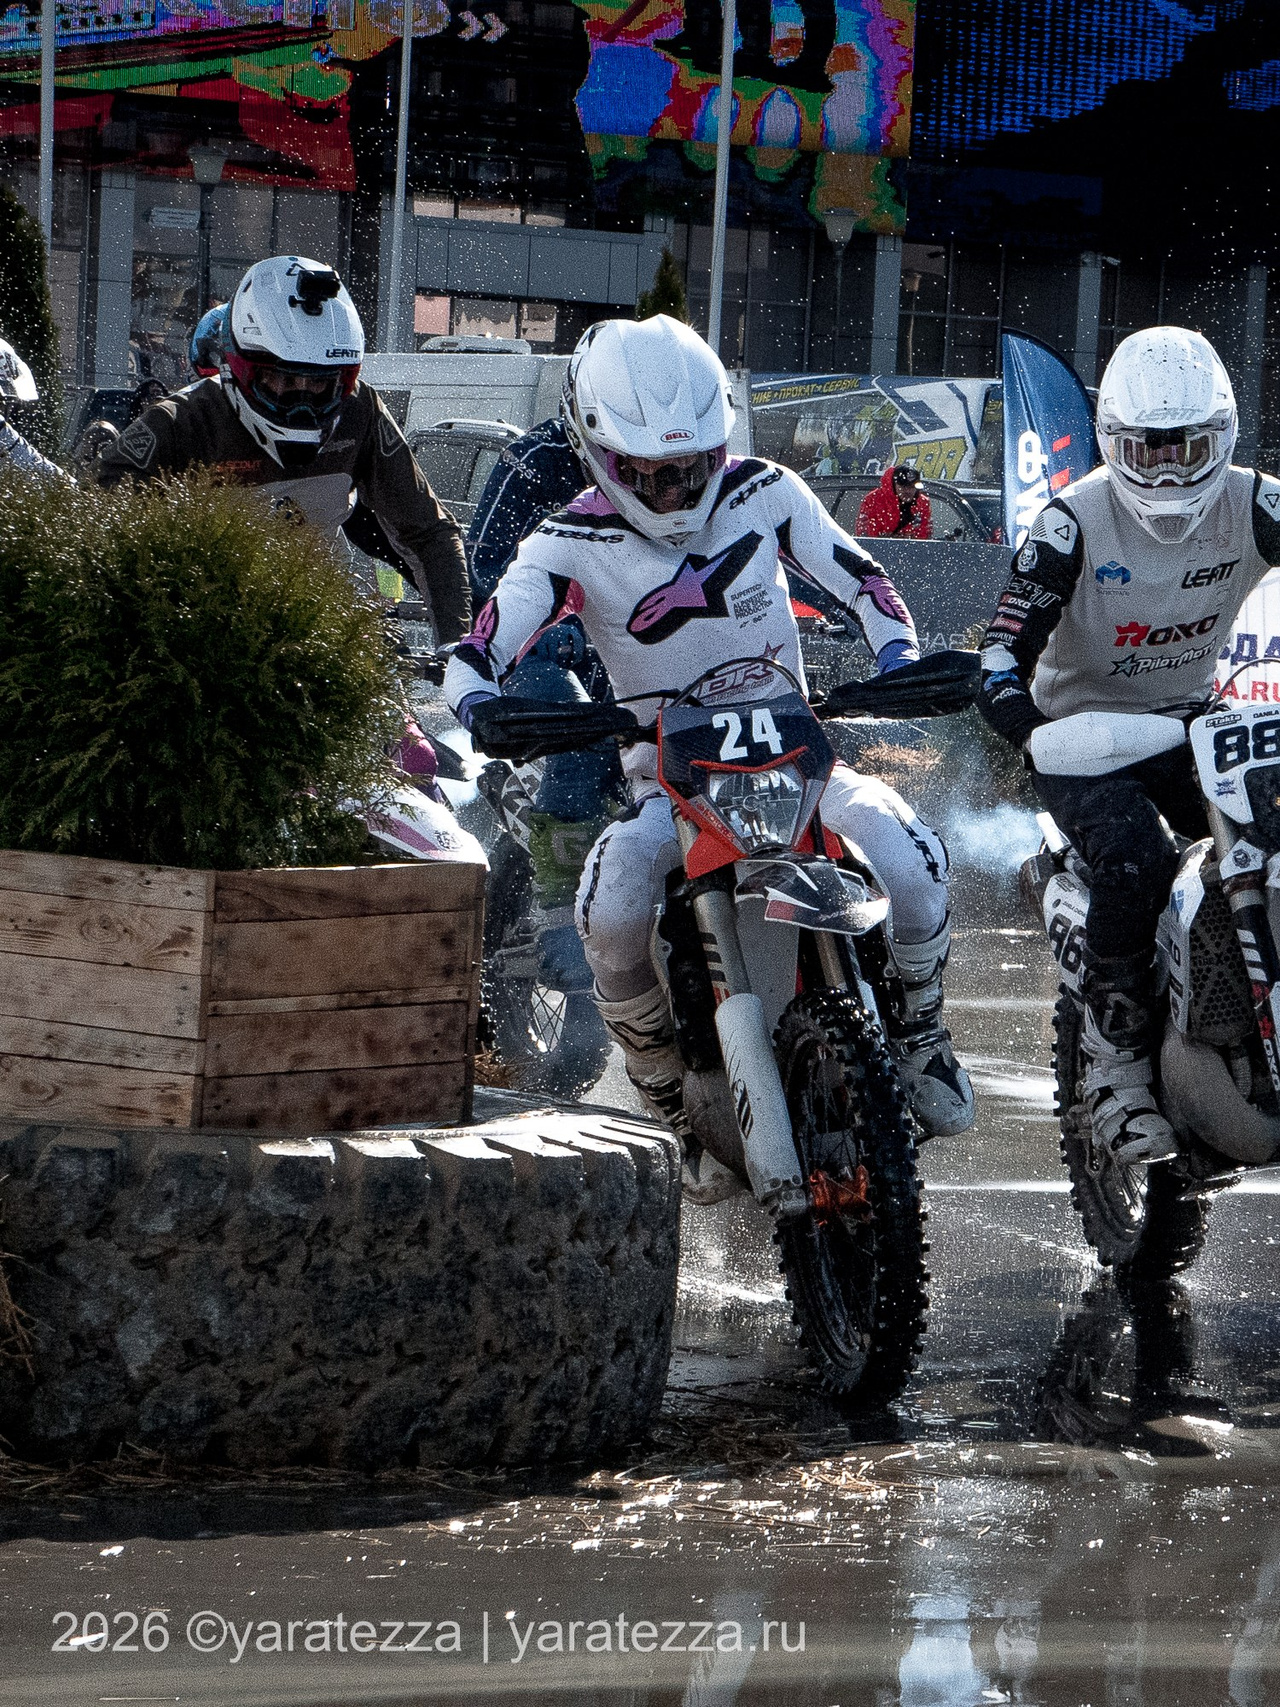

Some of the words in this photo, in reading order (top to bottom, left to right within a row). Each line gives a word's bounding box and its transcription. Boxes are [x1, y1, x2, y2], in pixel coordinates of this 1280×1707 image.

[779, 382, 817, 400] ПРОКАТ
[665, 432, 690, 440] BELL
[1181, 558, 1242, 589] LEATT
[1114, 613, 1220, 647] ROXO
[1253, 708, 1280, 719] DANILA
[712, 708, 783, 761] 24
